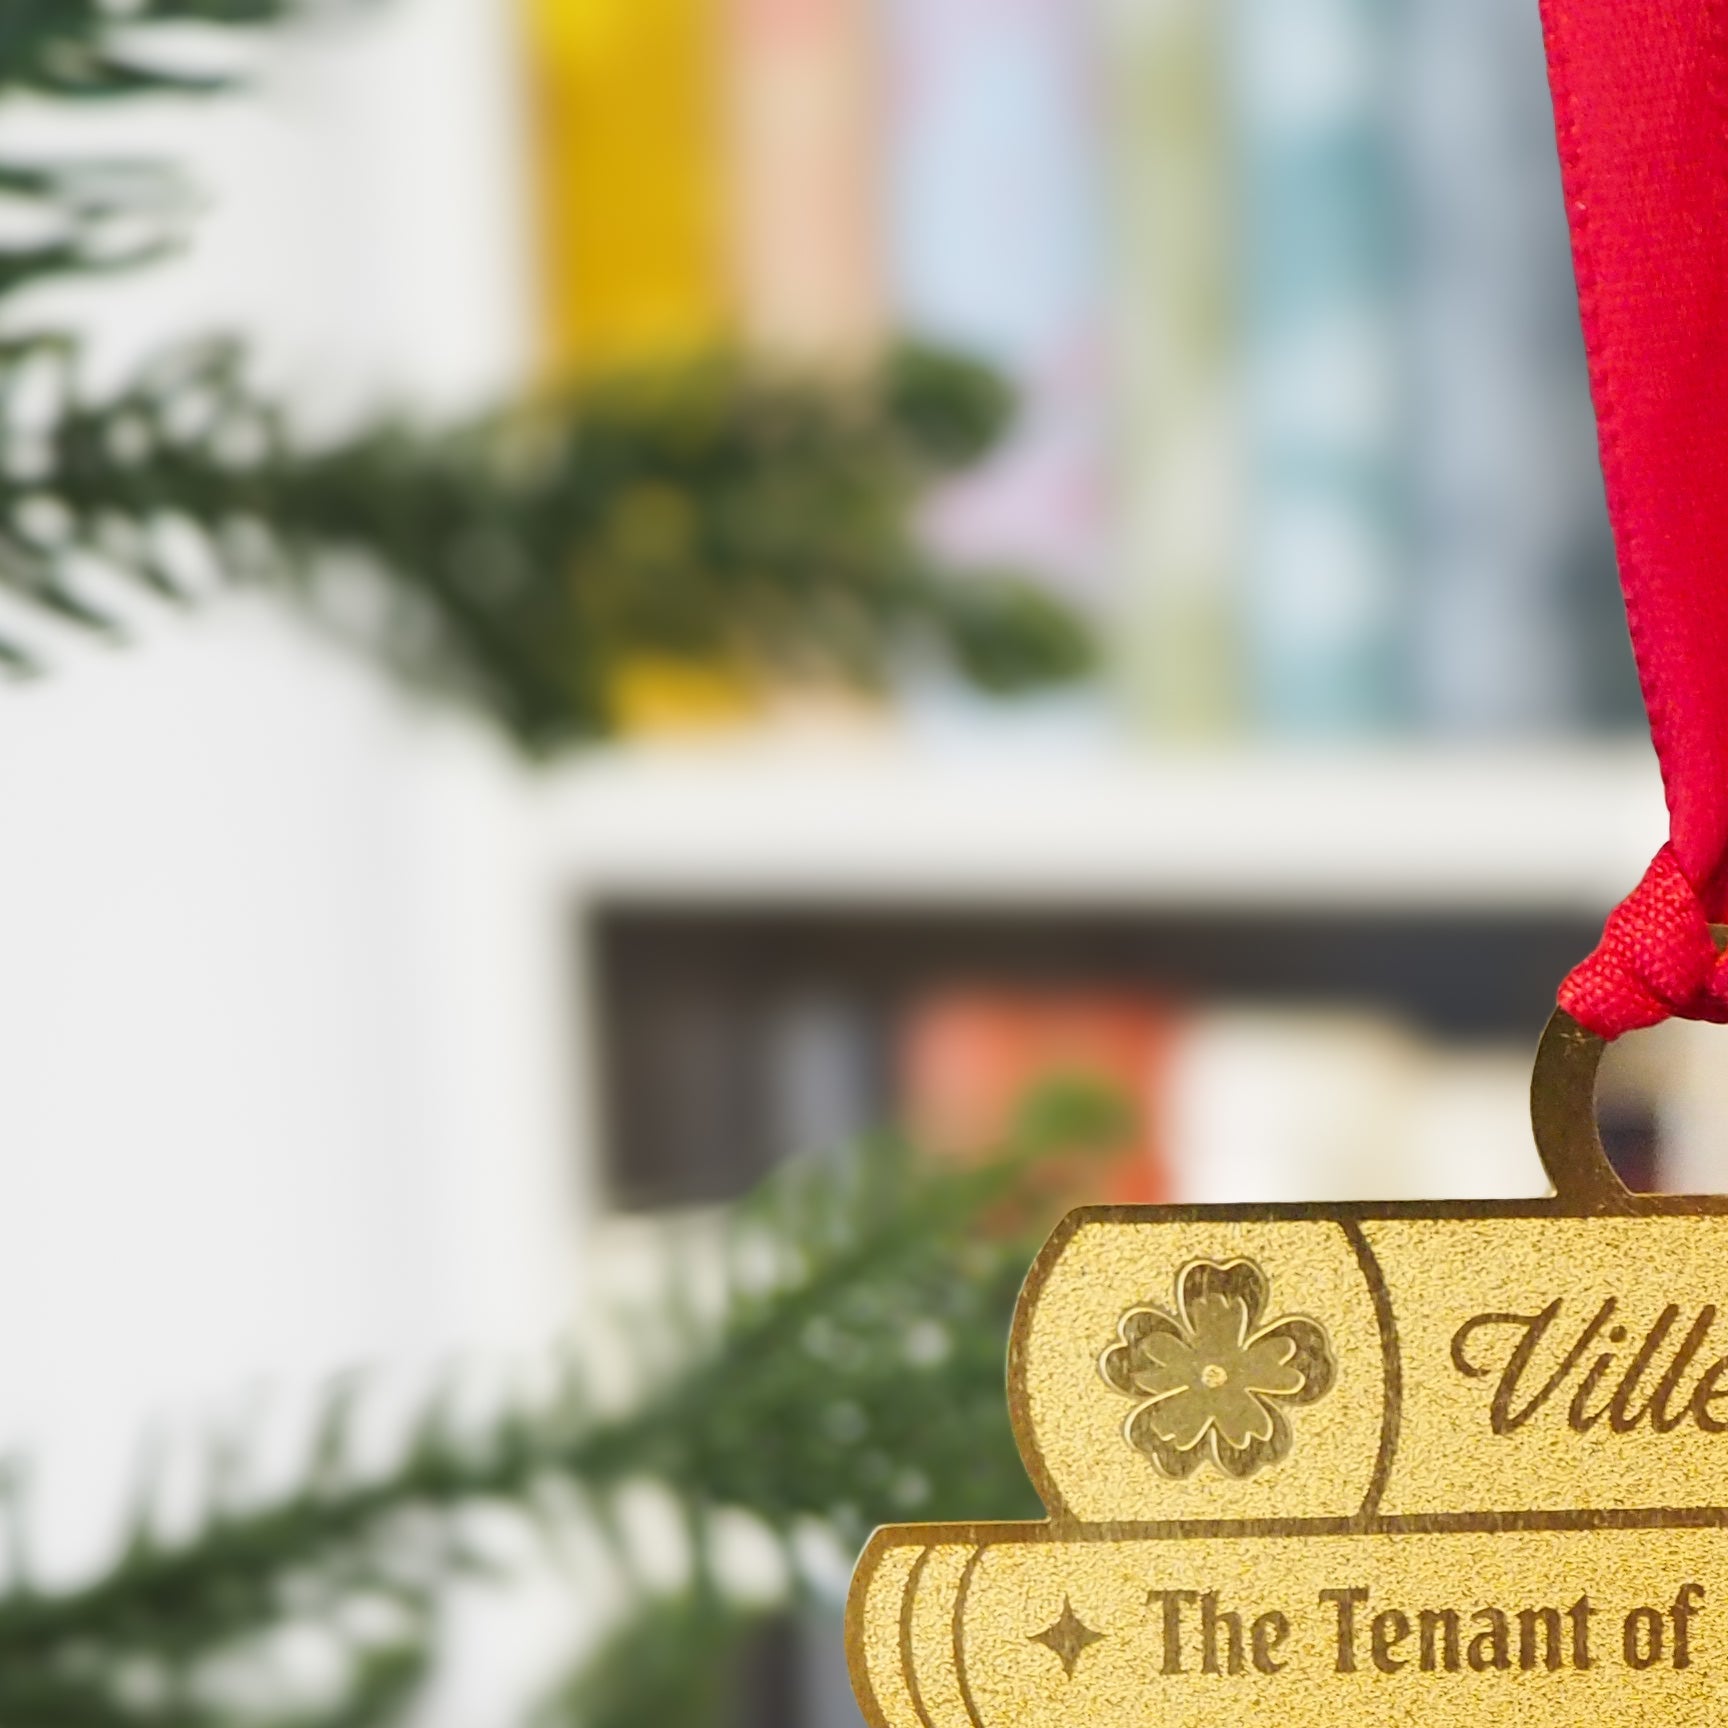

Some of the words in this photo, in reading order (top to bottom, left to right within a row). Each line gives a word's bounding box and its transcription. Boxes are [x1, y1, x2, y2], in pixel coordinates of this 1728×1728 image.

[1146, 1588, 1291, 1677] The
[1317, 1585, 1595, 1674] Tenant
[1622, 1581, 1704, 1671] of
